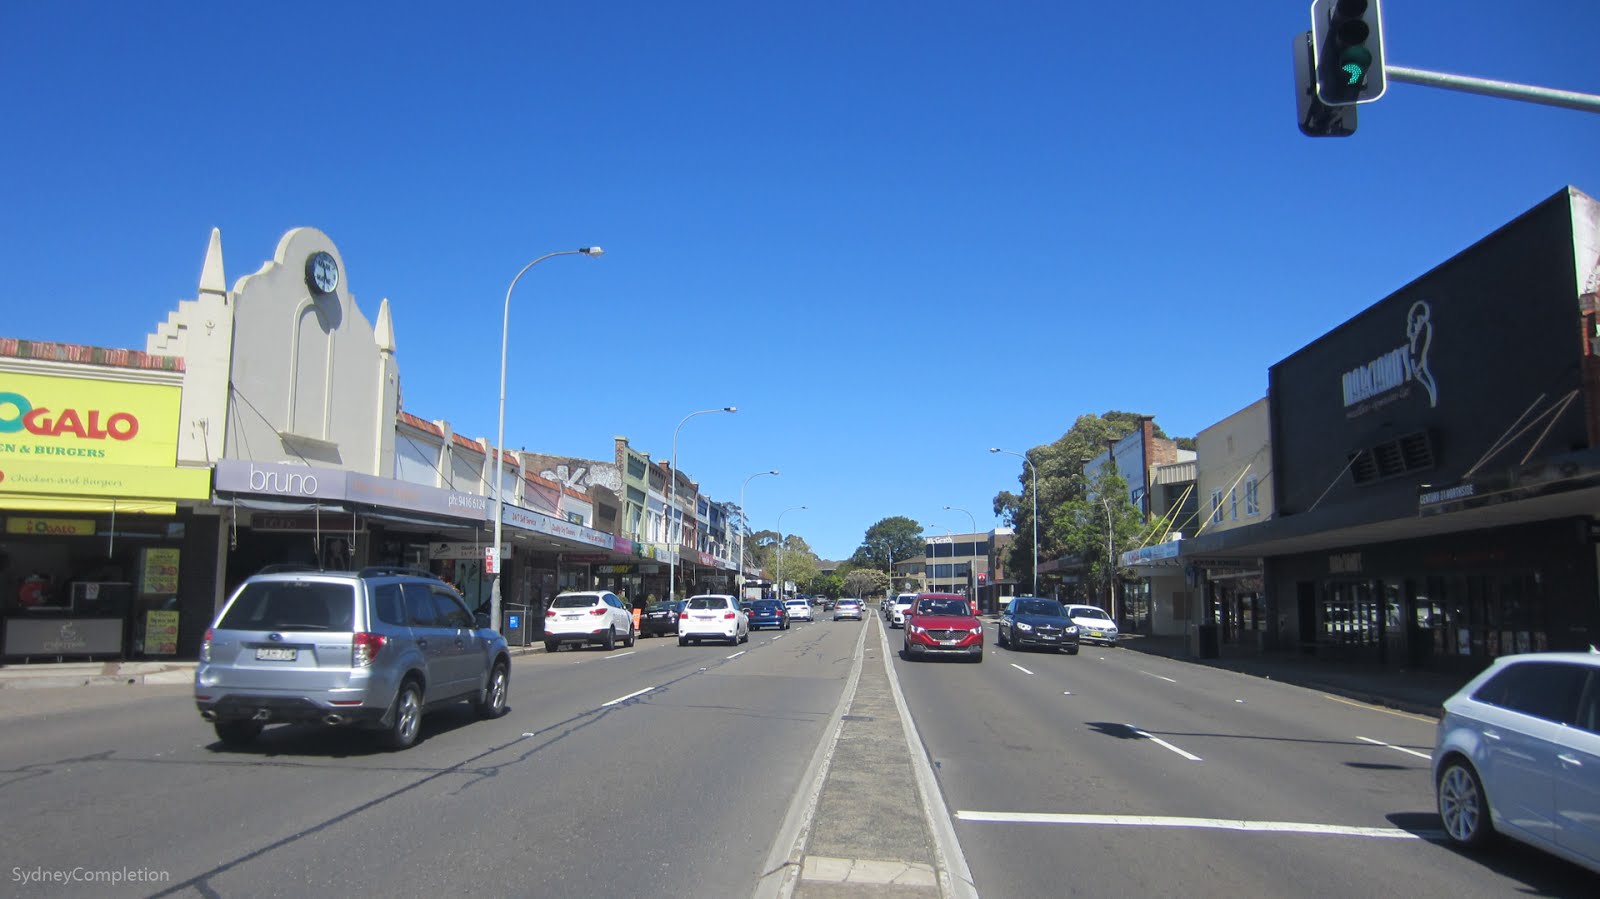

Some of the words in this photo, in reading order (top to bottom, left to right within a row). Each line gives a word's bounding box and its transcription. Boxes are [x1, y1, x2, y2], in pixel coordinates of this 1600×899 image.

[0, 392, 139, 441] OGALO
[19, 445, 30, 454] &
[34, 445, 105, 458] BURGERS
[10, 474, 54, 483] Chicken
[57, 477, 80, 485] and
[249, 463, 318, 495] bruno
[459, 495, 472, 508] 9416
[472, 498, 486, 510] 6124
[1420, 491, 1440, 504] CENTURY
[1446, 484, 1473, 499] NORTHSIDE
